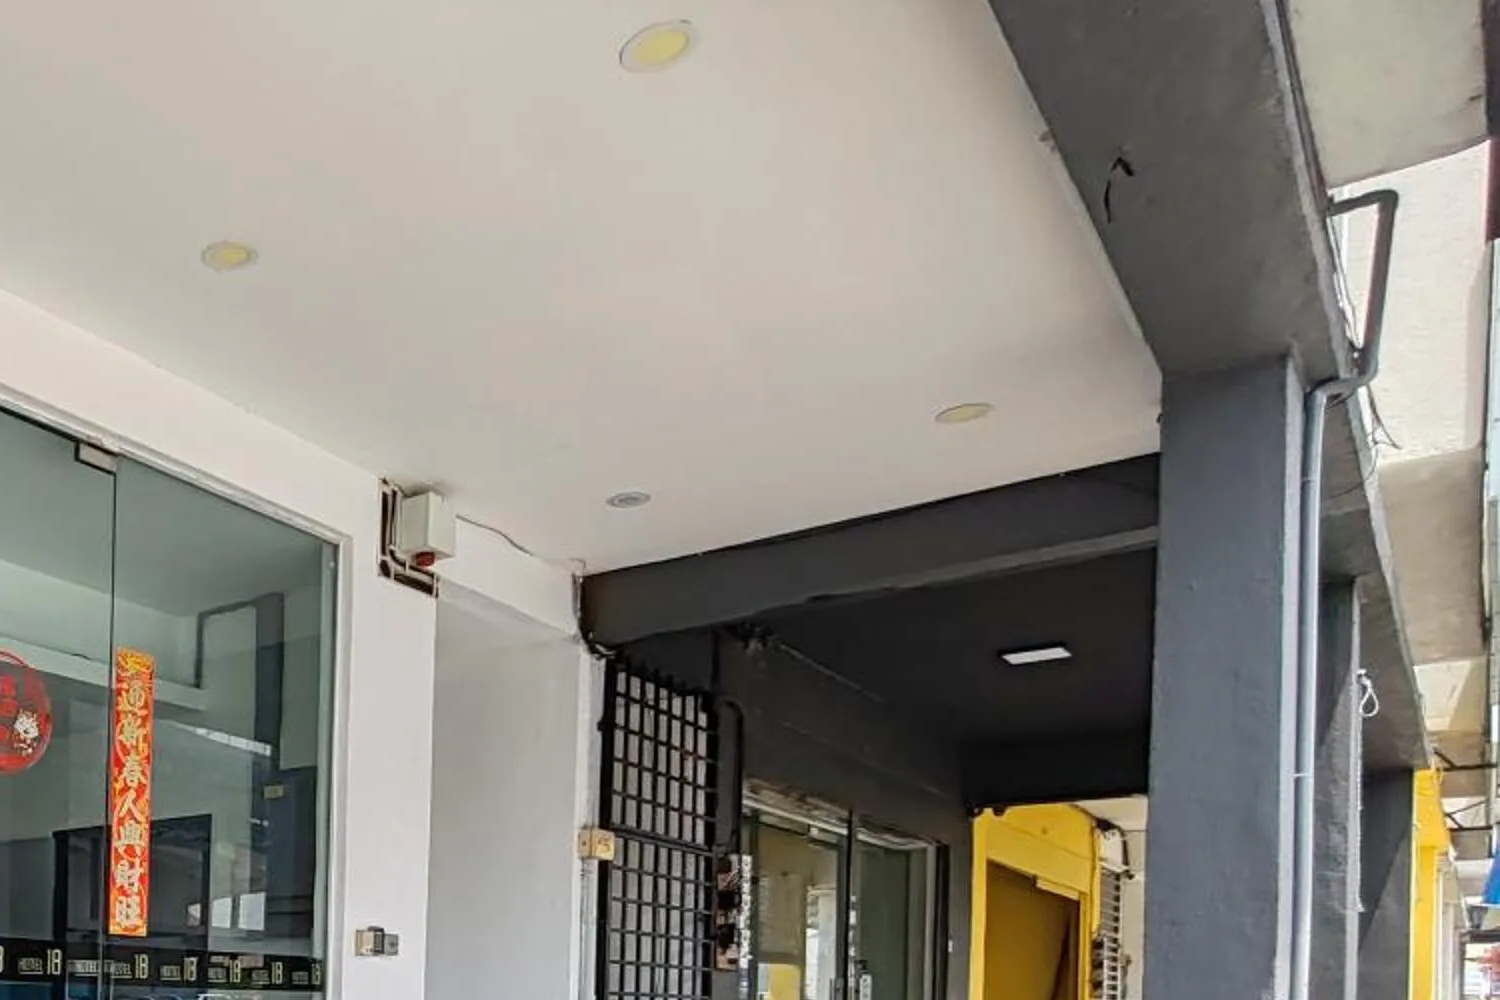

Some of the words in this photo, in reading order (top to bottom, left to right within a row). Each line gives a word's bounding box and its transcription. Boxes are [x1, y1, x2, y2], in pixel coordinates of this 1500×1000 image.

[47, 948, 62, 975] 18
[133, 953, 149, 979] 18
[183, 956, 198, 981] 18
[229, 959, 241, 983] 18
[271, 961, 283, 984] 18
